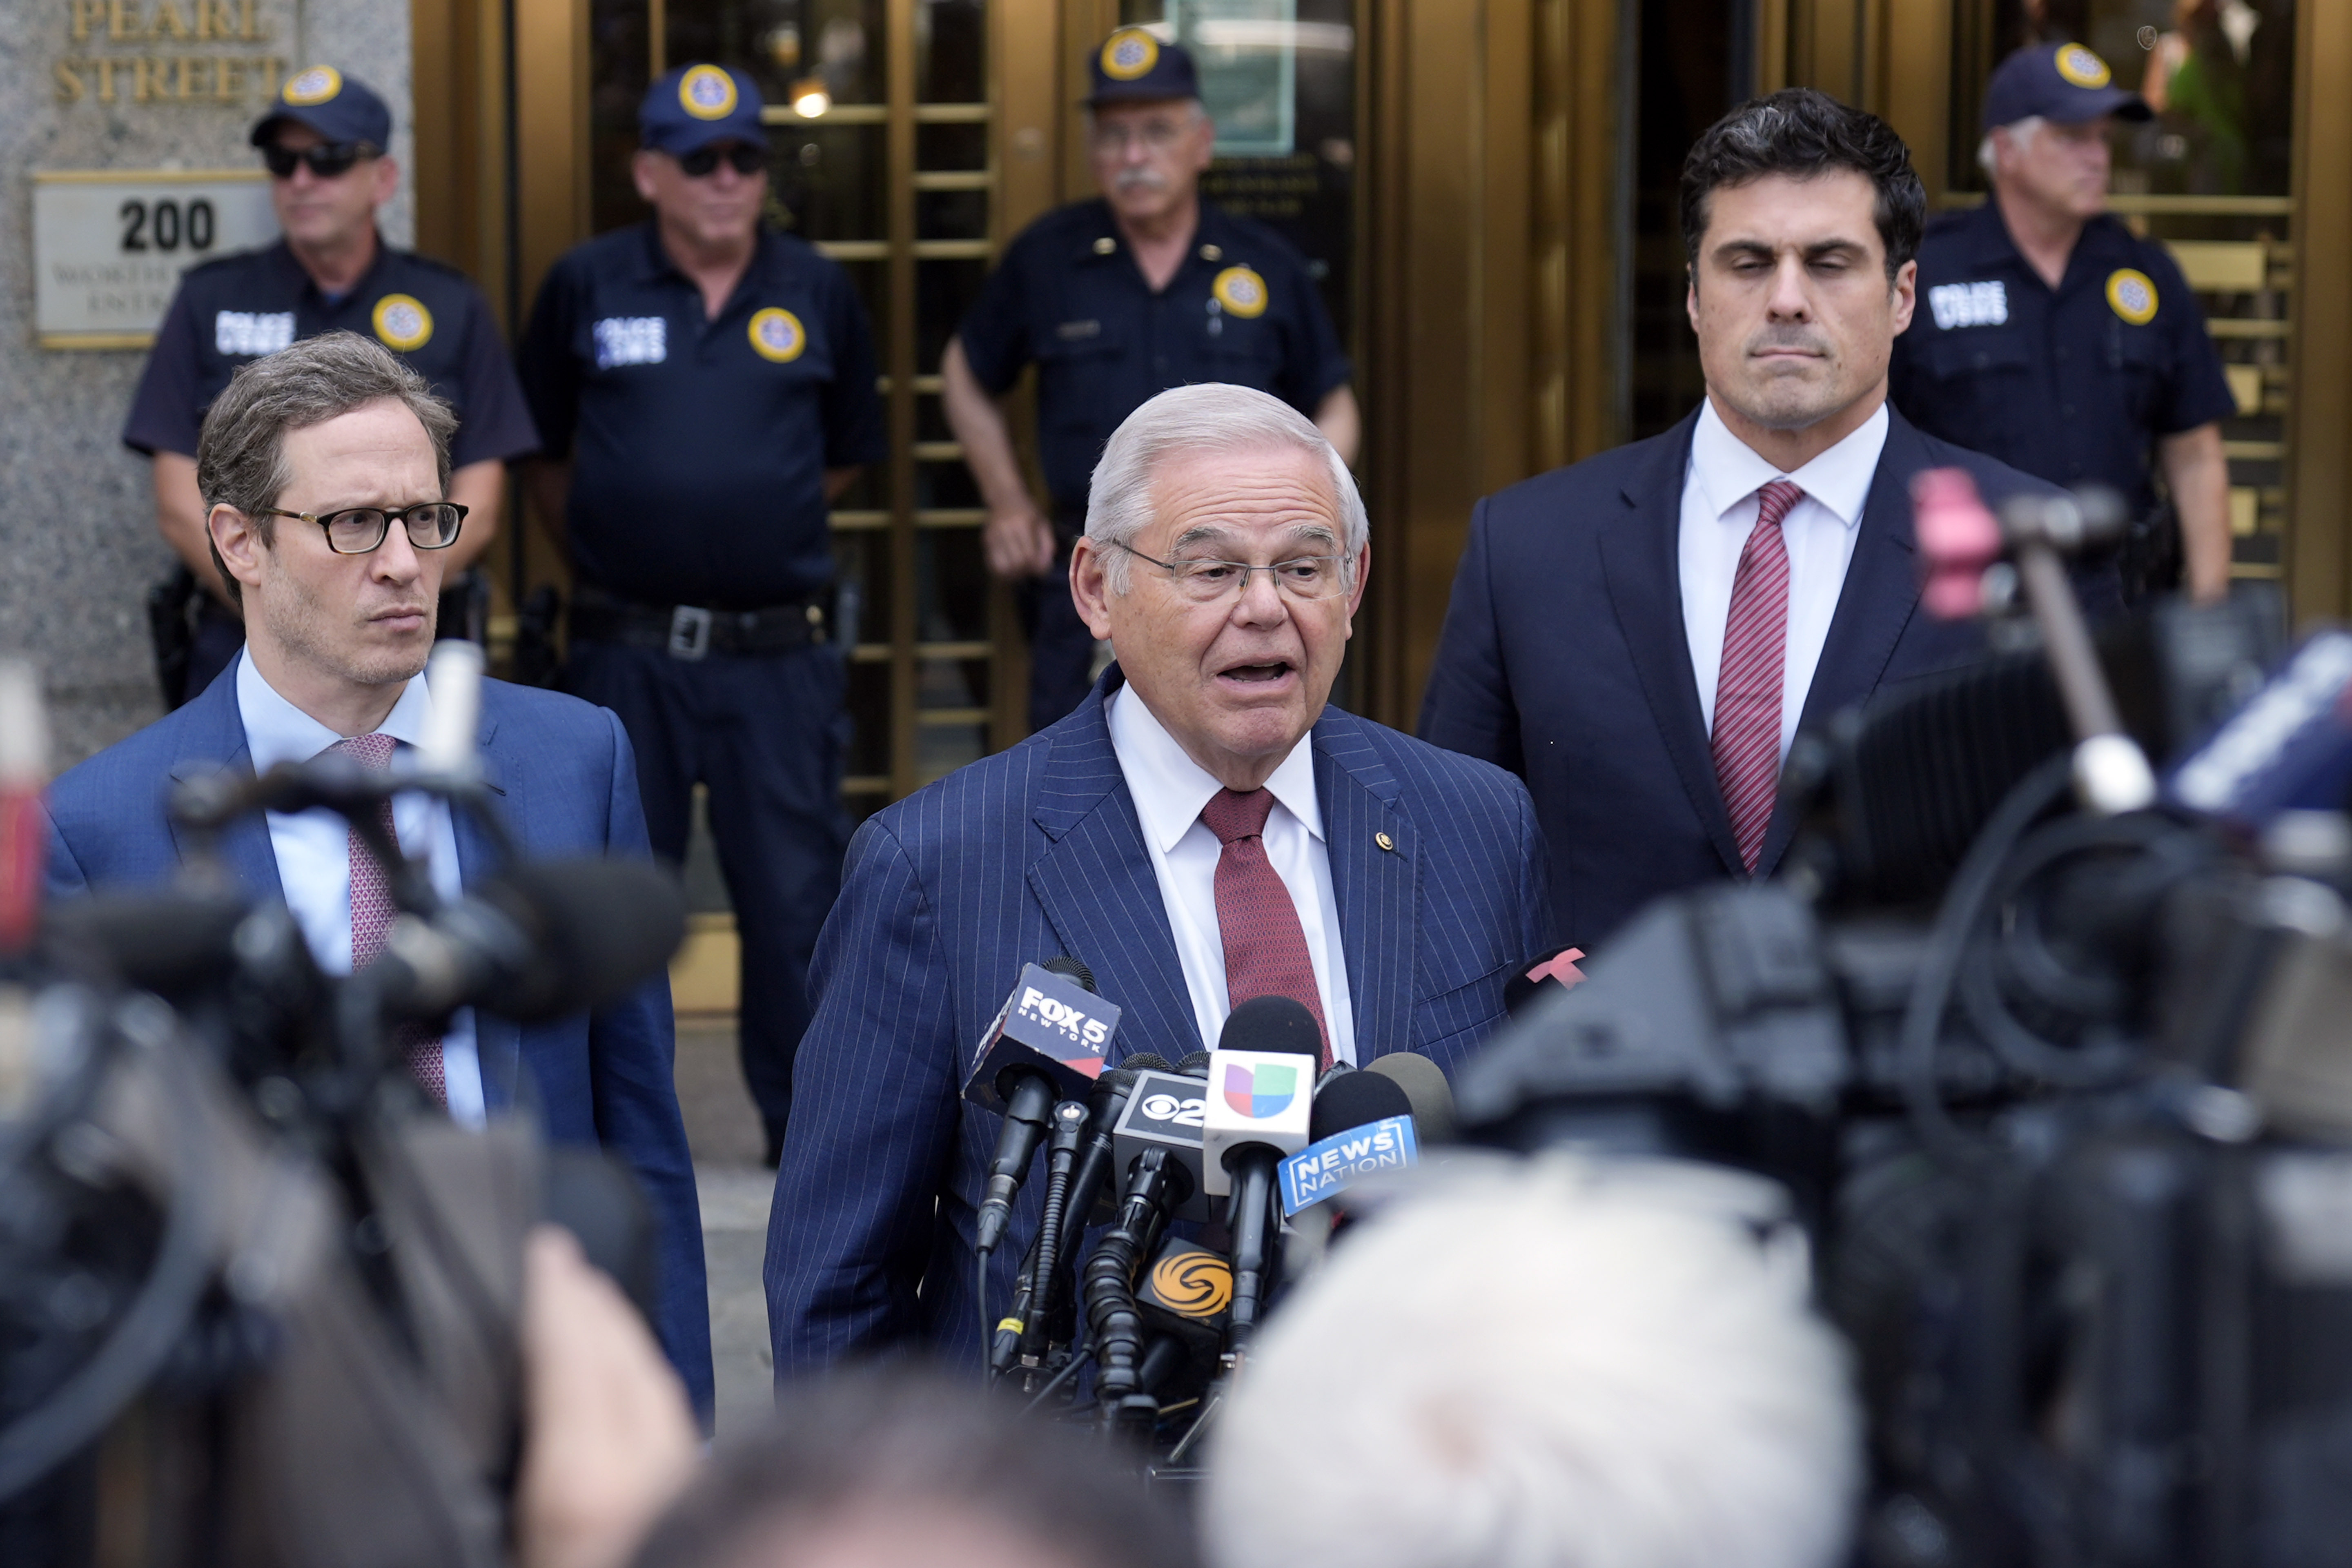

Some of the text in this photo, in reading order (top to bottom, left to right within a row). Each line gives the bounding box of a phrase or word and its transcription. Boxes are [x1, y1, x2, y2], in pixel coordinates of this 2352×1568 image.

[70, 0, 272, 41] PEARL
[54, 56, 289, 105] STREET
[120, 200, 215, 251] 200
[1018, 1007, 1100, 1054] NEW YORK
[1300, 1149, 1398, 1197] NATION
